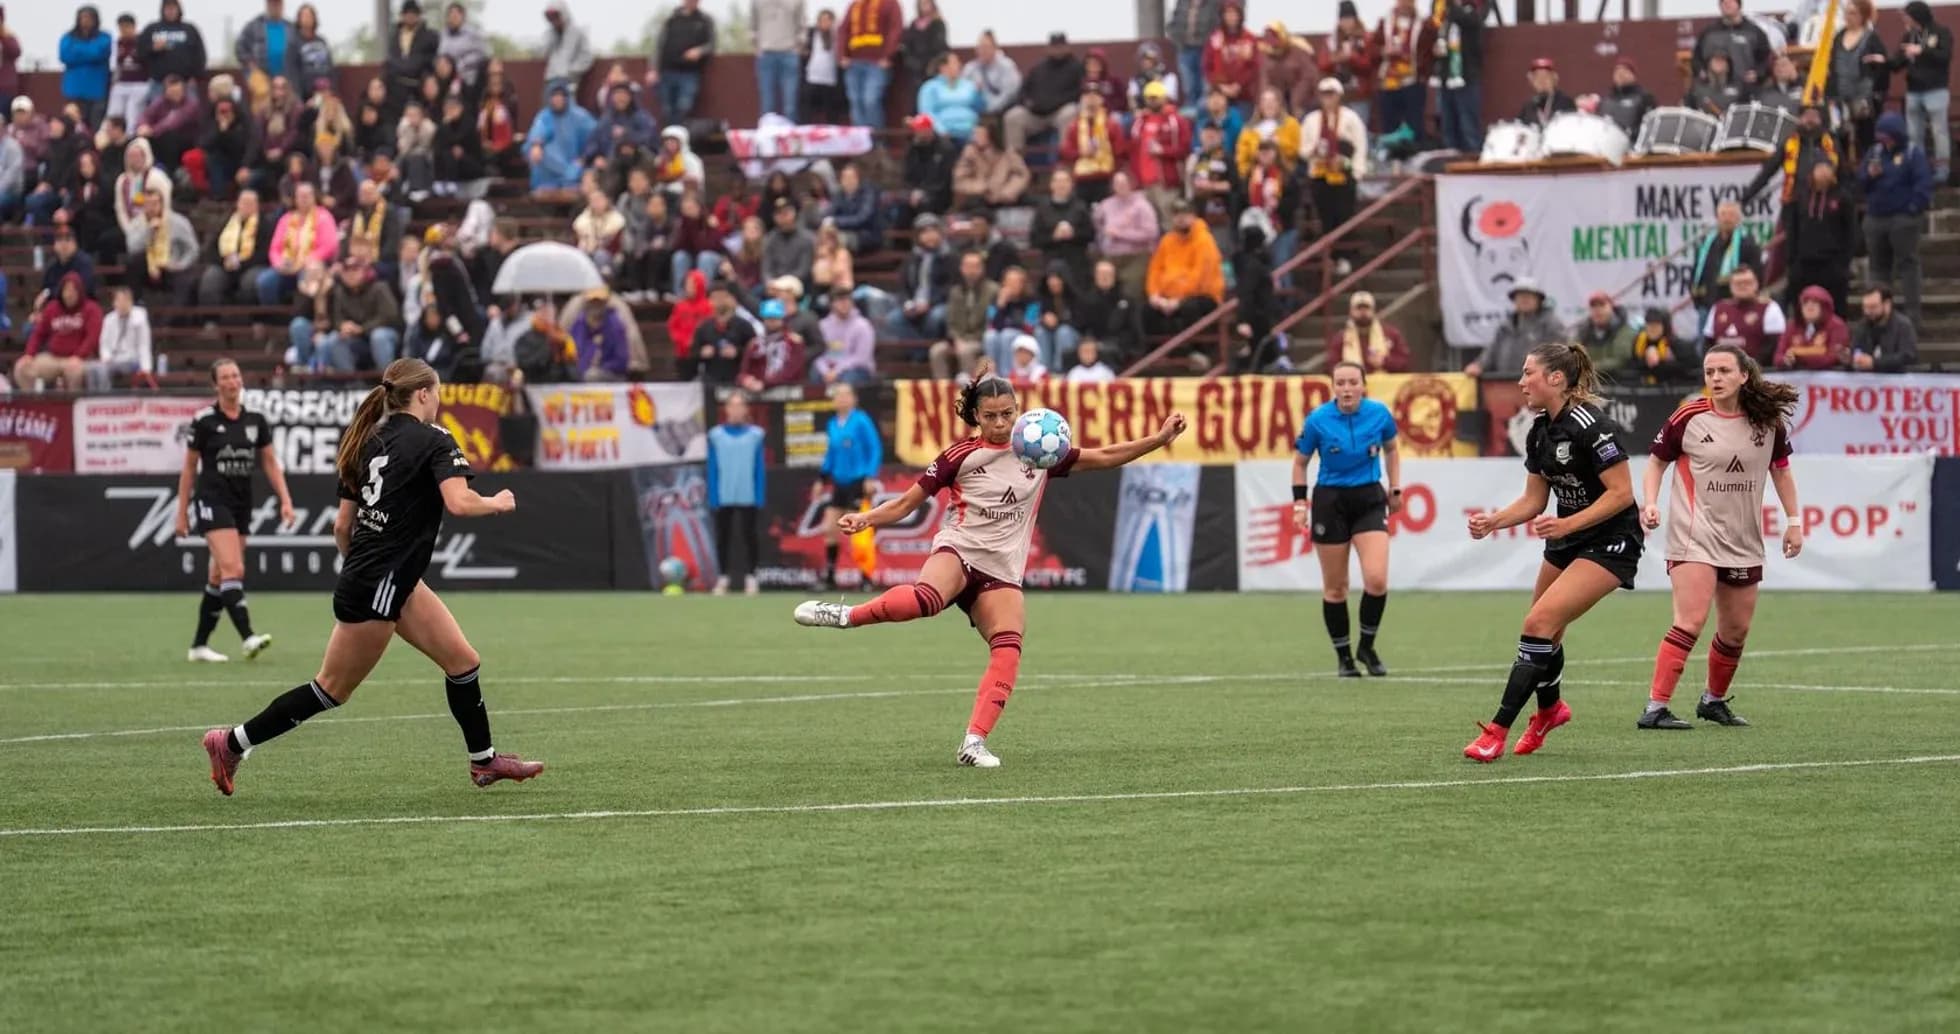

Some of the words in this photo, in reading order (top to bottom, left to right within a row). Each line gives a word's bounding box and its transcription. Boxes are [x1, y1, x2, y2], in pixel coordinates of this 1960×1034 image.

[1636, 184, 1703, 220] MAKE
[1572, 222, 1669, 262] MENTAL
[272, 426, 341, 474] ICE
[361, 455, 389, 506] 5
